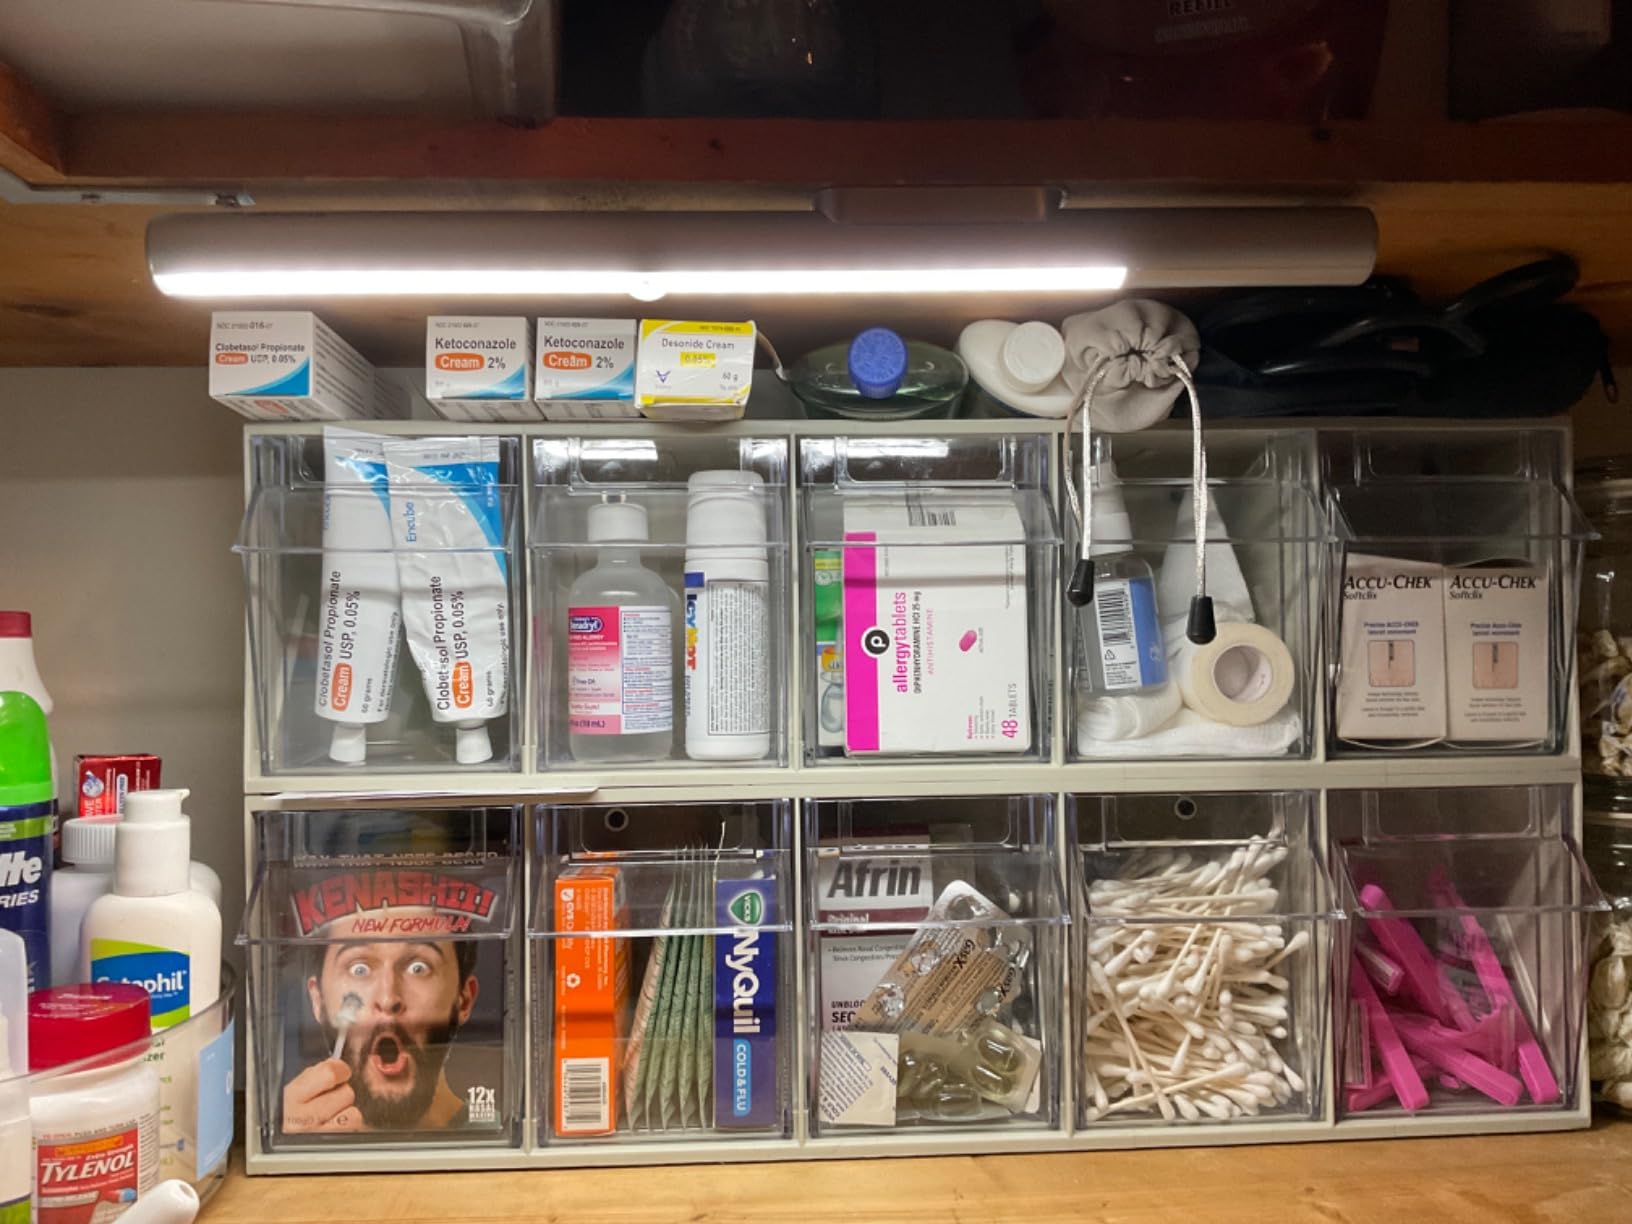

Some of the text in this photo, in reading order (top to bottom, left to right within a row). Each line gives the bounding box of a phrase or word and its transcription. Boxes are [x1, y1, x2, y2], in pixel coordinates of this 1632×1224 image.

[215, 343, 305, 353] Clobetasol Propionate
[435, 338, 517, 350] Ketoconazole
[543, 336, 625, 349] Ketoconazole
[661, 338, 735, 350] Desonide Cream
[218, 354, 245, 362] Cream
[271, 354, 296, 364] 0.05%
[440, 355, 506, 370] Cream 2%
[548, 354, 614, 370] Cream 2%
[404, 501, 417, 543] Encube
[1344, 574, 1433, 590] ACCU-CHEK
[1450, 574, 1537, 590] ACCU-CHEK
[429, 576, 447, 643] Propionate
[318, 571, 341, 707] Clobetasol Propionate
[334, 590, 361, 709] Cream USP, 0.05%
[450, 590, 471, 706] Cream USP, 0.05%
[925, 608, 935, 675] ANTIHISTAMINE
[912, 625, 922, 694] DIPHENHYDRAMINE
[1000, 682, 1019, 739] 48 TABLETS
[826, 858, 921, 898] Afrin
[0, 889, 39, 908] RIES
[743, 894, 753, 922] VICKS
[351, 915, 471, 933] NEW FORMULA
[725, 931, 760, 1034] NyQuil
[39, 1151, 135, 1185] TYLENOL
